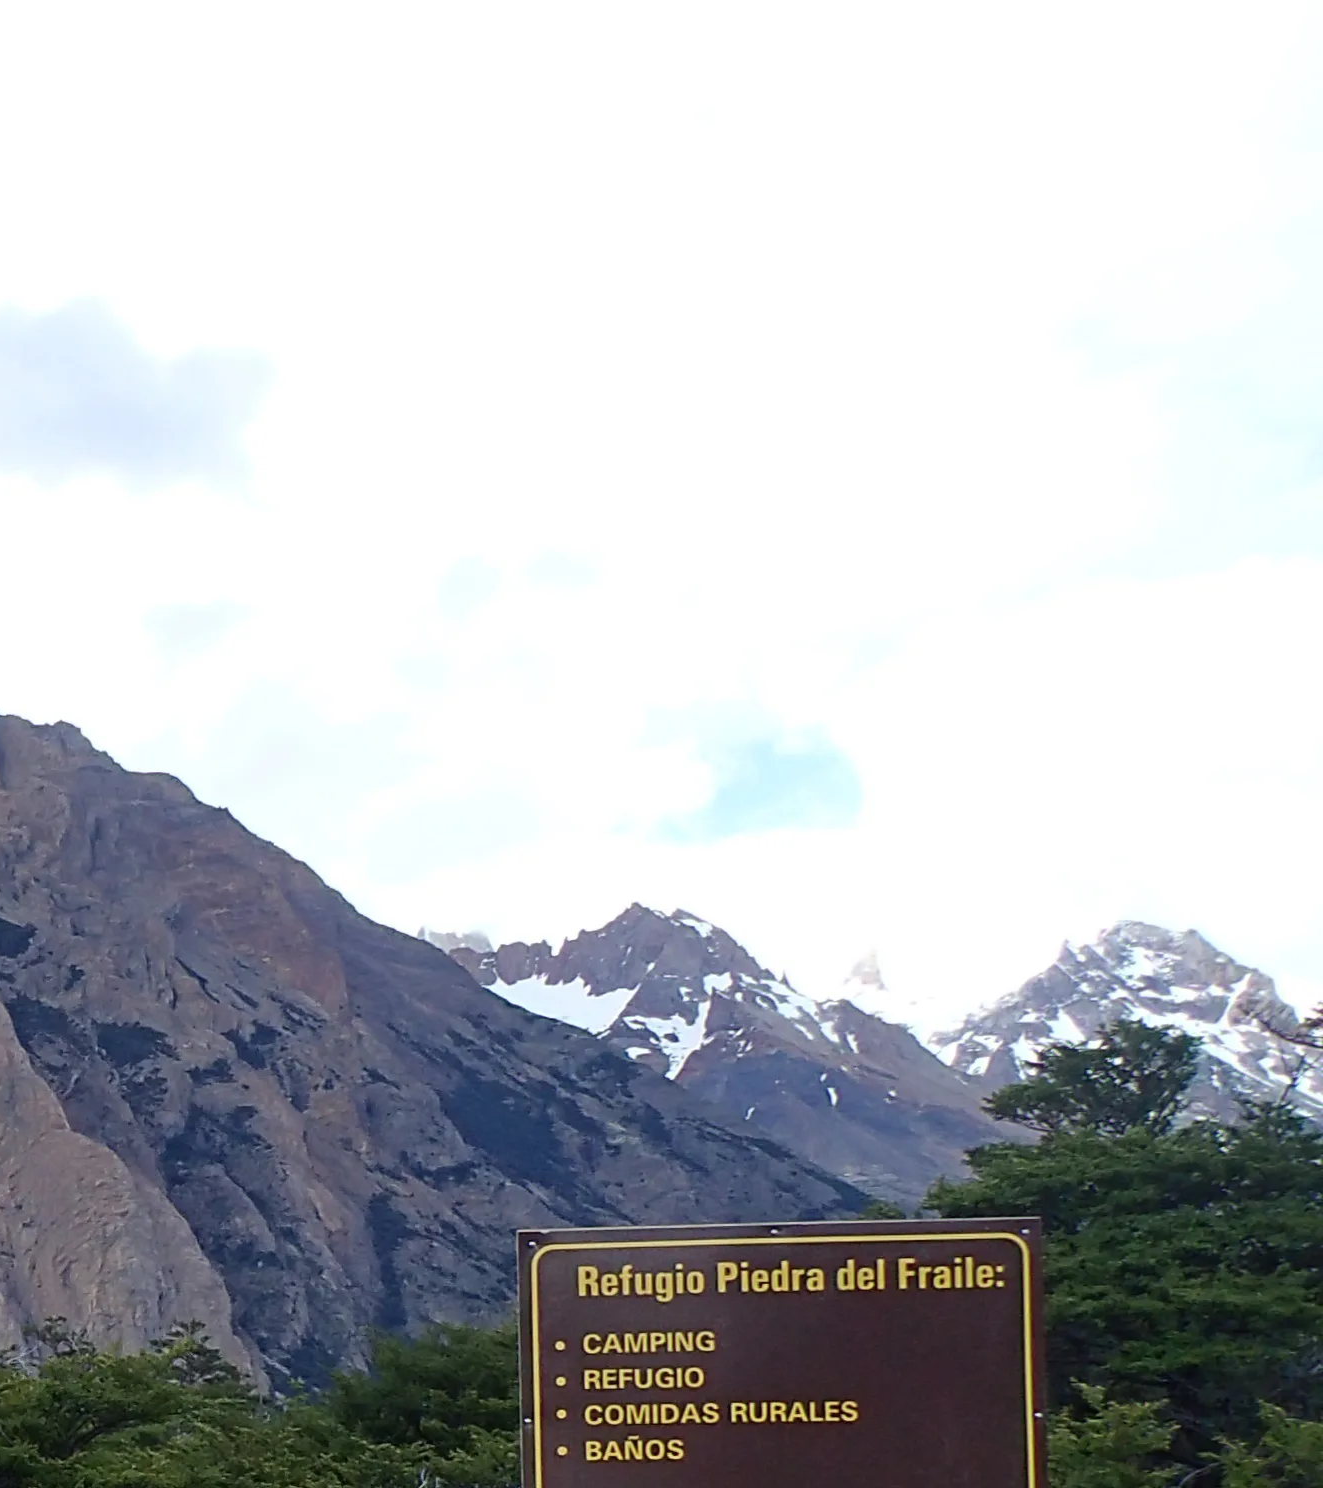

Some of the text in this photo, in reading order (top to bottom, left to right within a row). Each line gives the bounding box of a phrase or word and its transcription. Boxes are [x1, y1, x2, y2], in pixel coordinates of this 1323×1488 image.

[577, 1256, 1006, 1302] Refugio Piedra del Fraile:
[582, 1331, 716, 1355] CAMPING
[583, 1367, 705, 1390] REFUGIO
[584, 1400, 859, 1426] COMIDAS RURALES
[585, 1435, 685, 1461] BAÑOS
